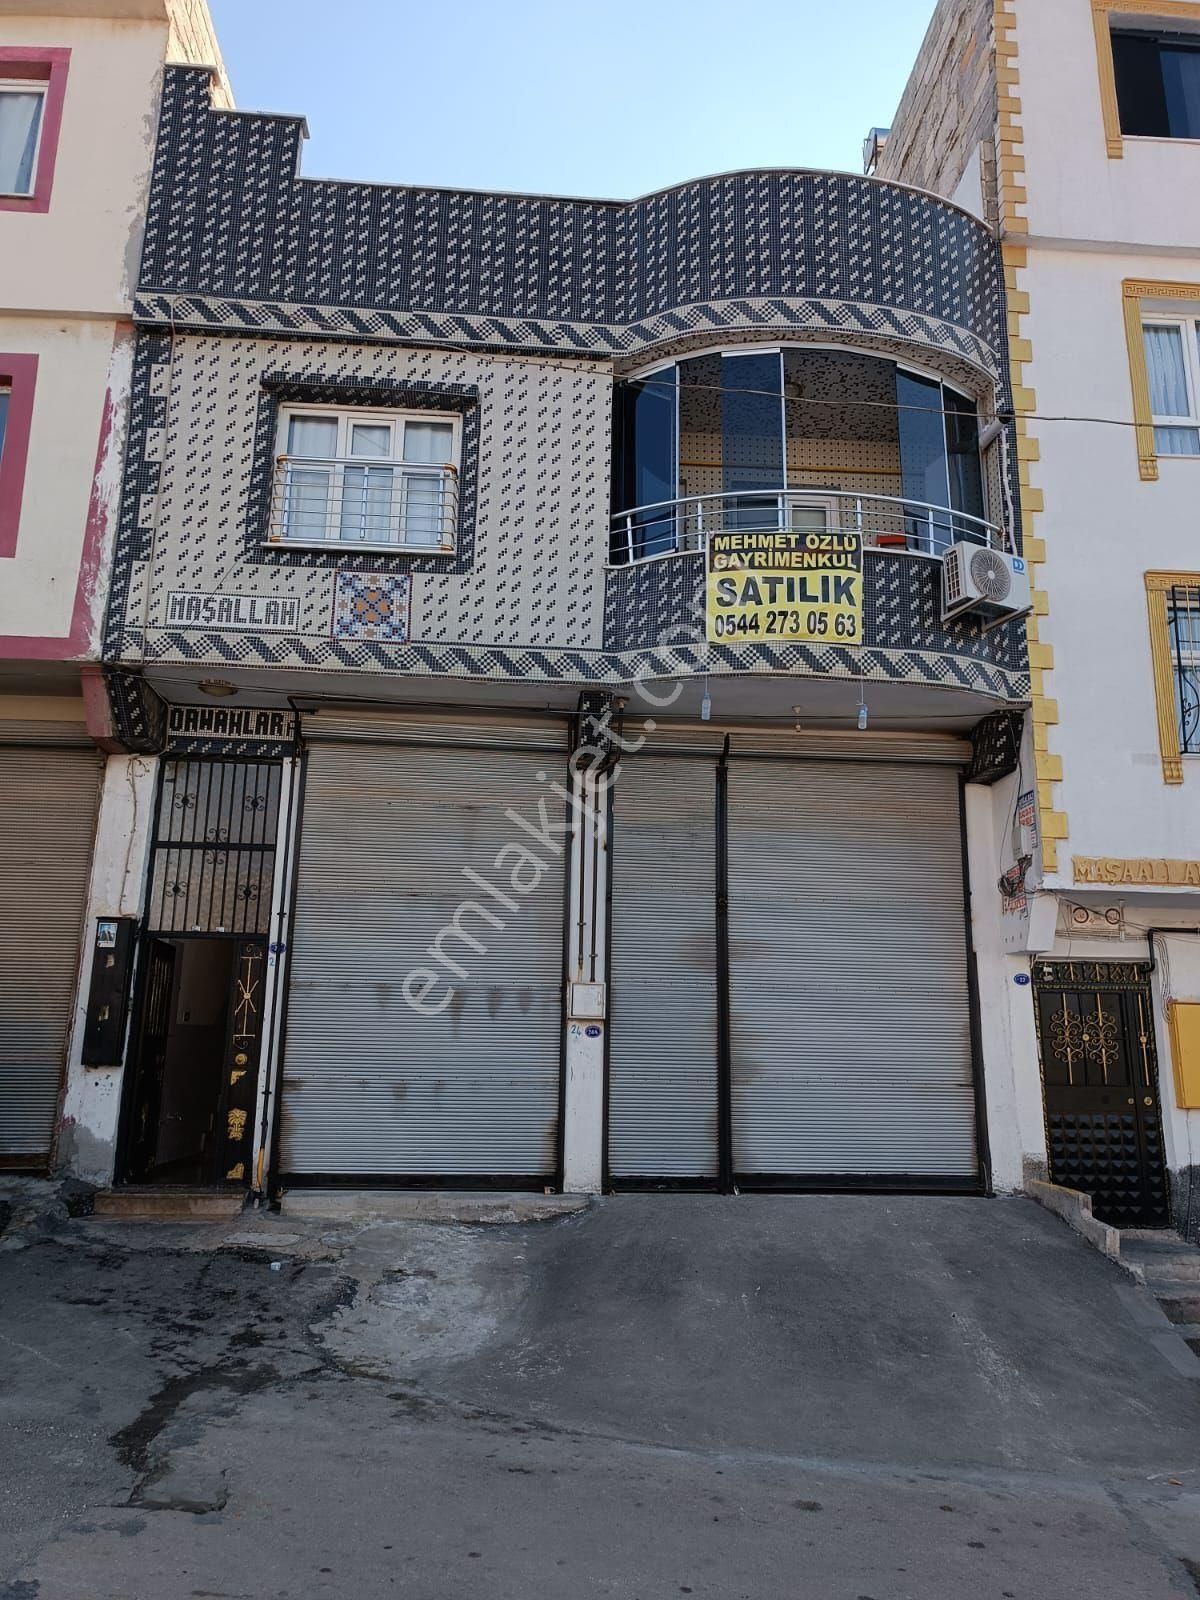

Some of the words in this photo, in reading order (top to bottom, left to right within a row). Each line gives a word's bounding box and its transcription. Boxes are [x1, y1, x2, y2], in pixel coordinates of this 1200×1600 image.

[715, 535, 799, 552] MEHMET
[806, 533, 857, 552] ÖZLÜ
[715, 549, 857, 570] GAYRİMENKUL
[716, 575, 857, 608] SATILIK
[171, 595, 296, 626] MAŞALLAH
[715, 613, 759, 638] 0544
[766, 610, 800, 635] 273
[807, 611, 828, 635] 05
[834, 613, 857, 638] 63
